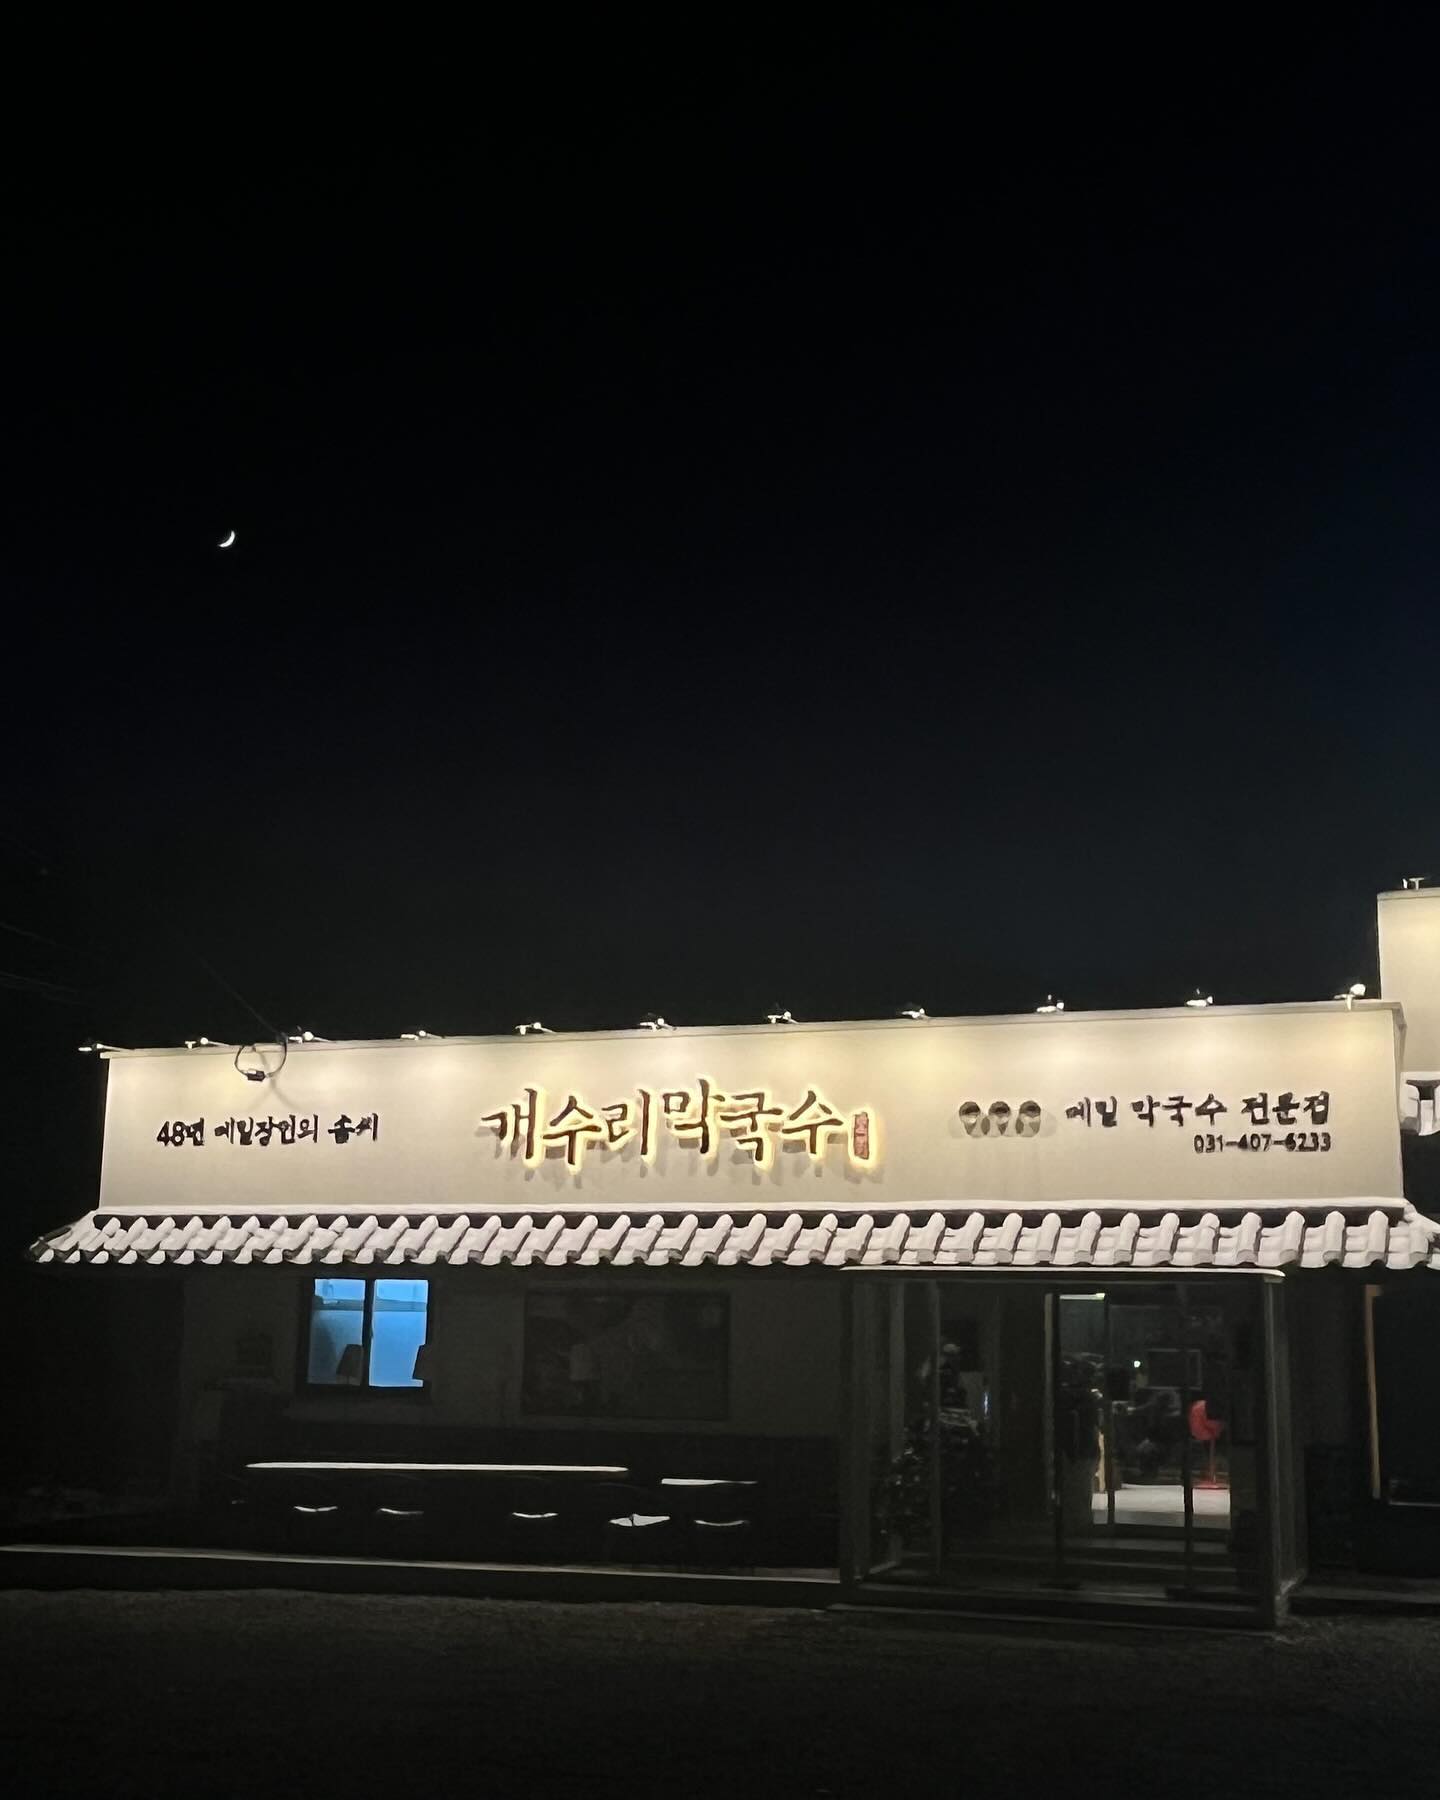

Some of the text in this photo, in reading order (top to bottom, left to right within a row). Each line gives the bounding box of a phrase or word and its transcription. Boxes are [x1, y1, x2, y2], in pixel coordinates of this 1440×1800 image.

[481, 1078, 844, 1166] 개수리막국수
[1065, 1090, 1330, 1128] 메밀 막국수 전문점
[156, 1117, 205, 1147] 48년
[327, 1112, 379, 1145] 솜씨
[1193, 1132, 1331, 1154] 031-407-6233
